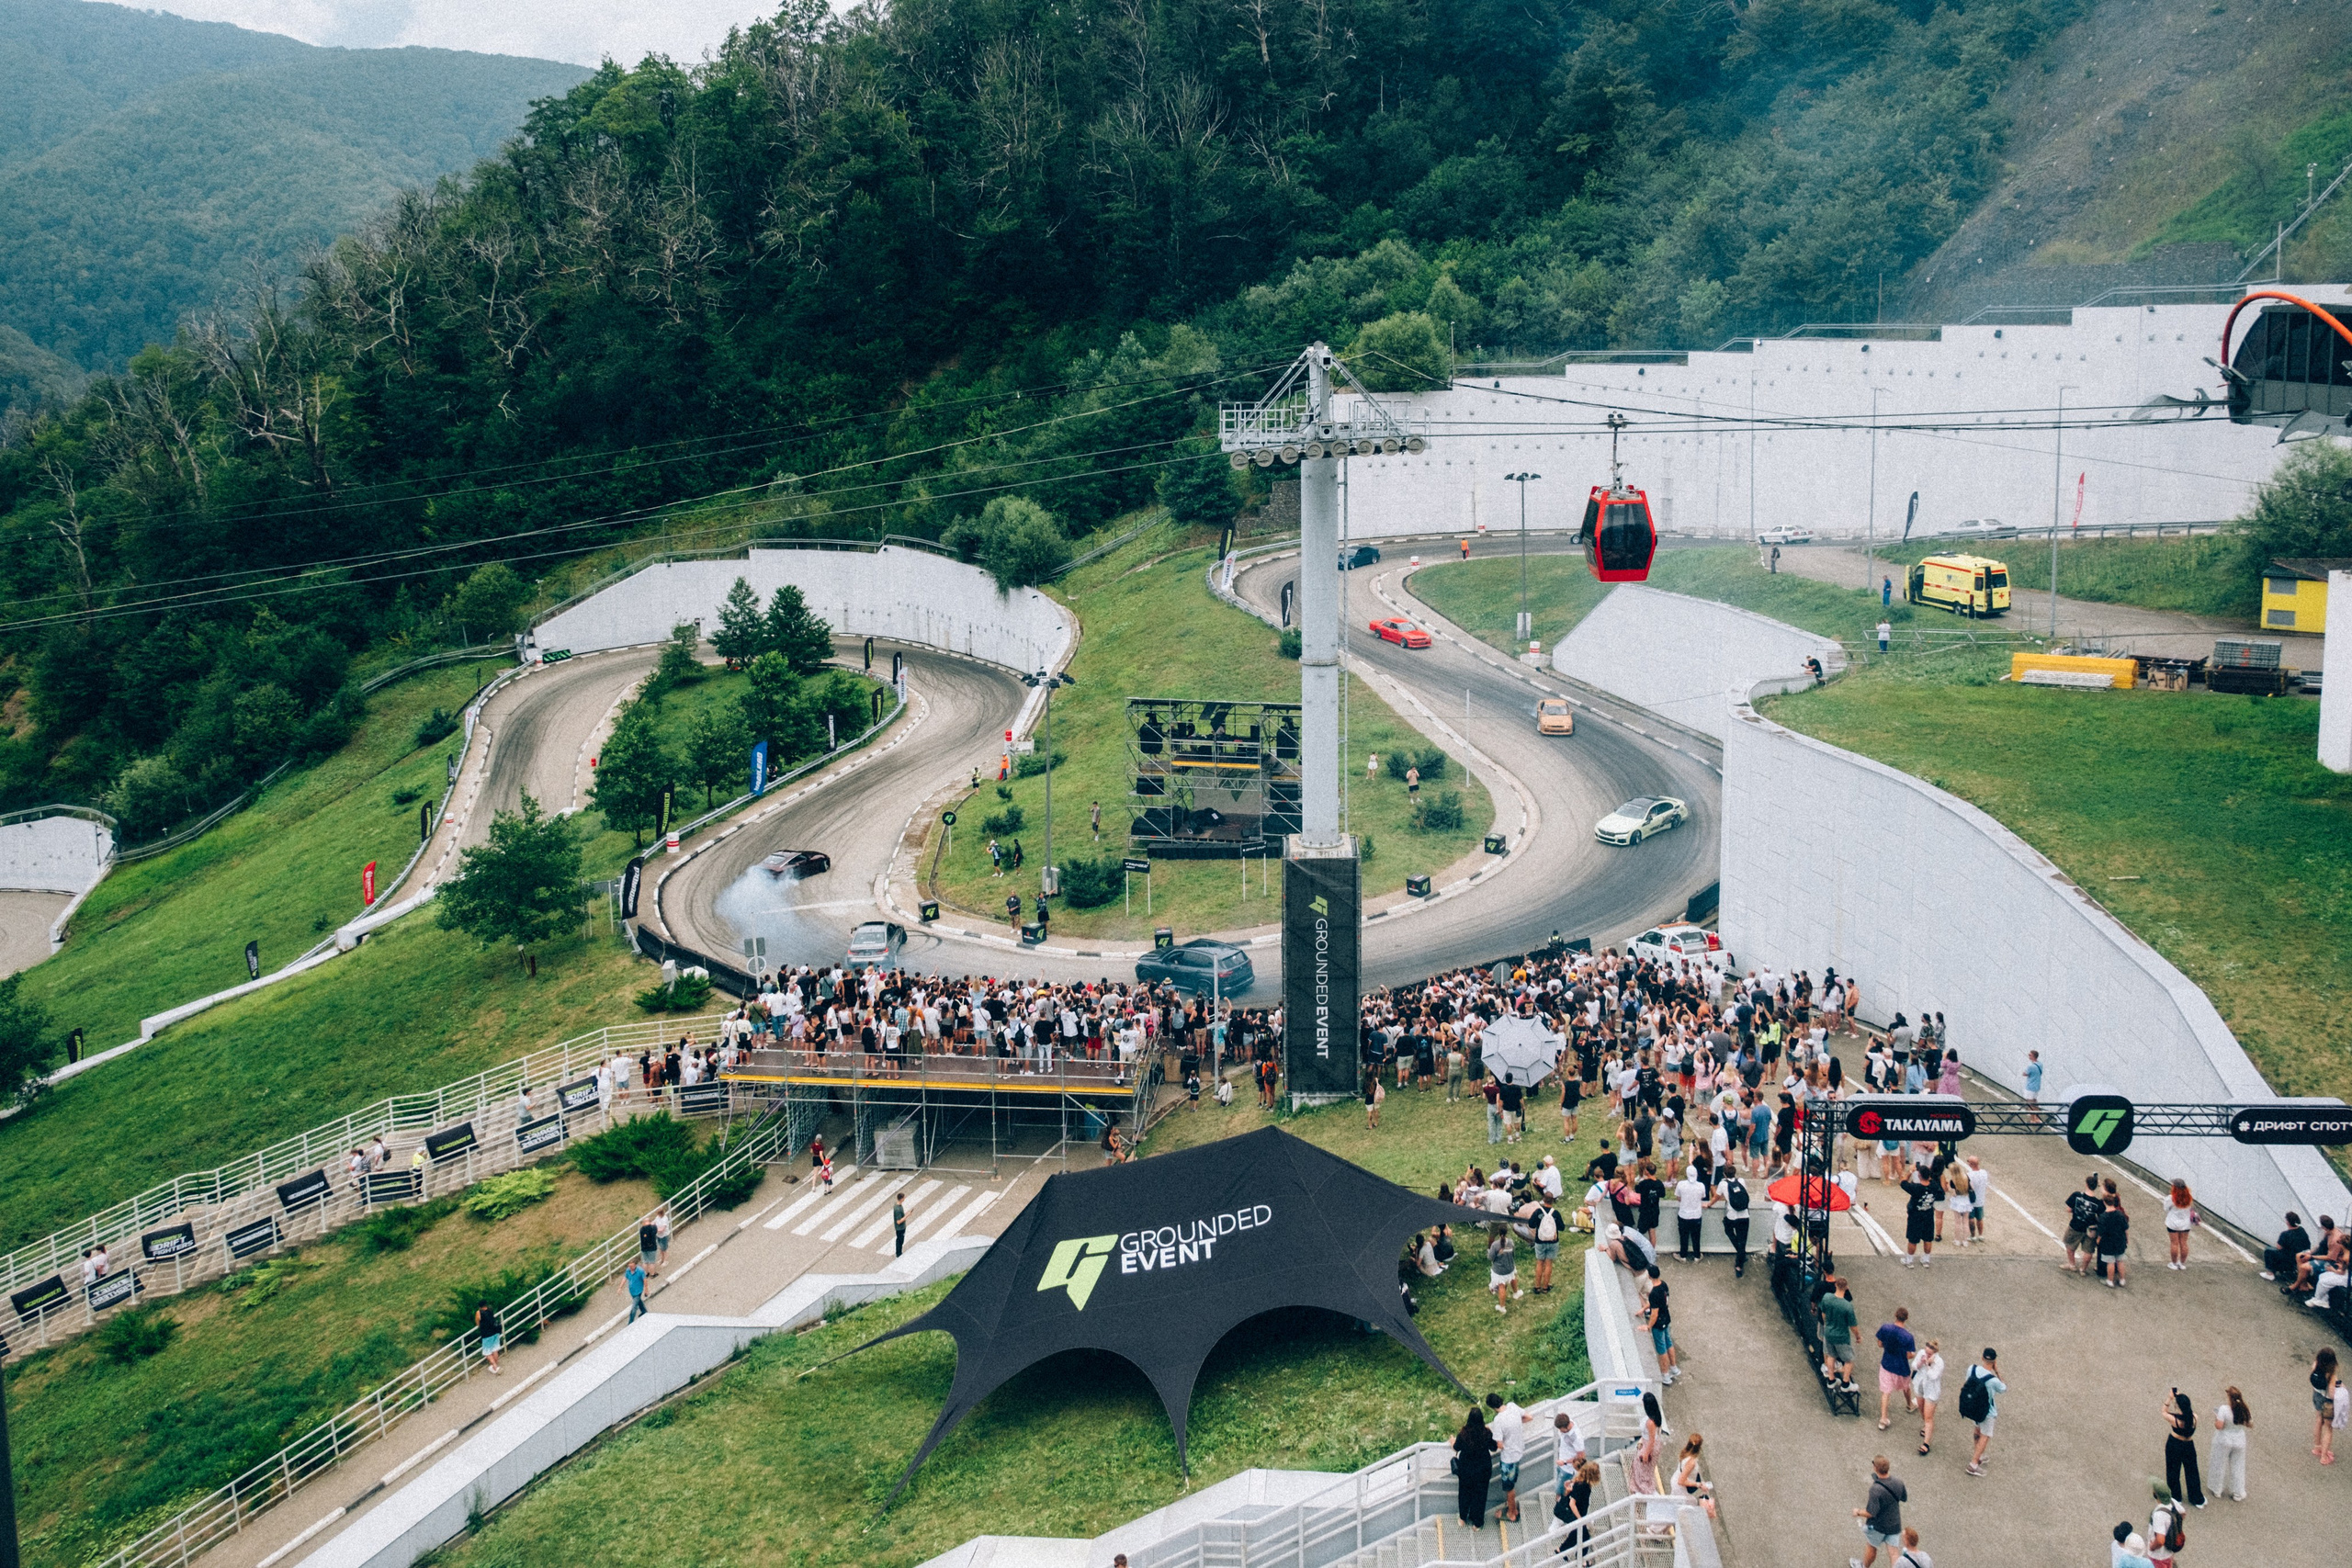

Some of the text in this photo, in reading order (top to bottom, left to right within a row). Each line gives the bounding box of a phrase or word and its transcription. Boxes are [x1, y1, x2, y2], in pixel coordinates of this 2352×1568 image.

[568, 1091, 600, 1104] FIGHTER
[571, 1085, 597, 1100] DRIFT
[1883, 1118, 1964, 1133] TAKAYAMA
[2253, 1121, 2307, 1133] ДРИФТ
[1120, 1204, 1272, 1254] GROUNDED
[153, 1239, 194, 1257] FIGHTERS
[155, 1235, 187, 1251] DRIFT
[1121, 1236, 1217, 1274] EVENT
